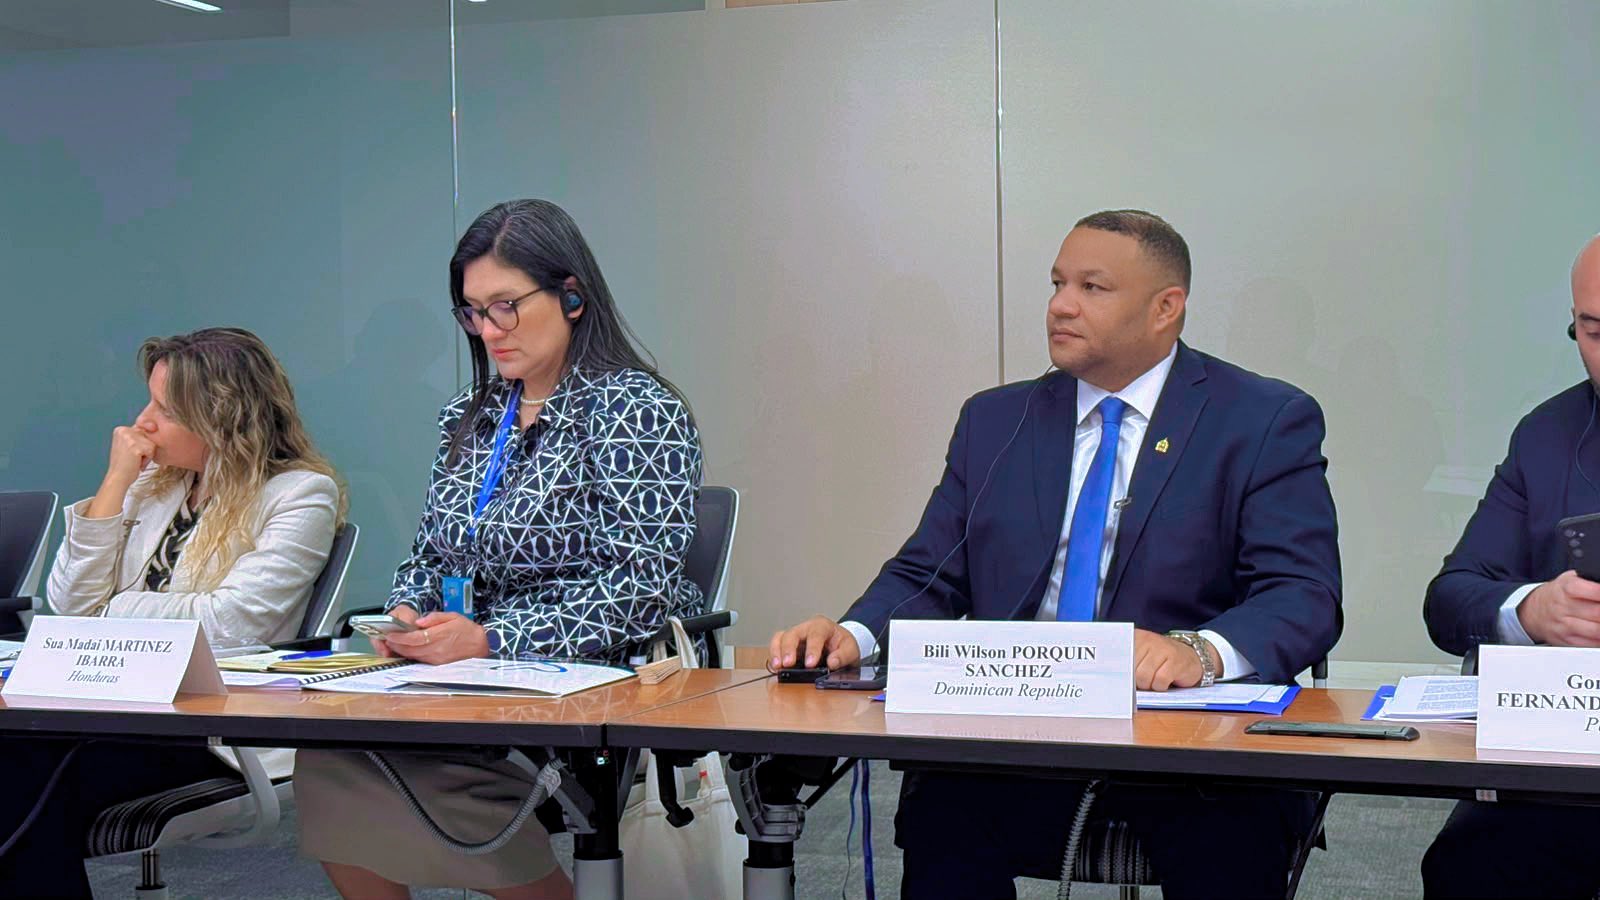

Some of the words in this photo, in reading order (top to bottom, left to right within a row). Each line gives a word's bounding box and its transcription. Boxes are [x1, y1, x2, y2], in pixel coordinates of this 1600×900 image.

[43, 637, 64, 650] Sua
[66, 638, 102, 651] Madai
[102, 640, 173, 653] MARTINEZ
[75, 655, 125, 668] IBARRA
[923, 645, 950, 659] Bili
[954, 645, 1006, 659] Wilson
[1012, 646, 1097, 662] PORQUIN
[67, 670, 120, 683] Honduras
[965, 664, 1053, 679] SANCHEZ
[934, 682, 1014, 697] Dominican
[1018, 683, 1083, 701] Republic
[1496, 693, 1600, 711] FERNAND
